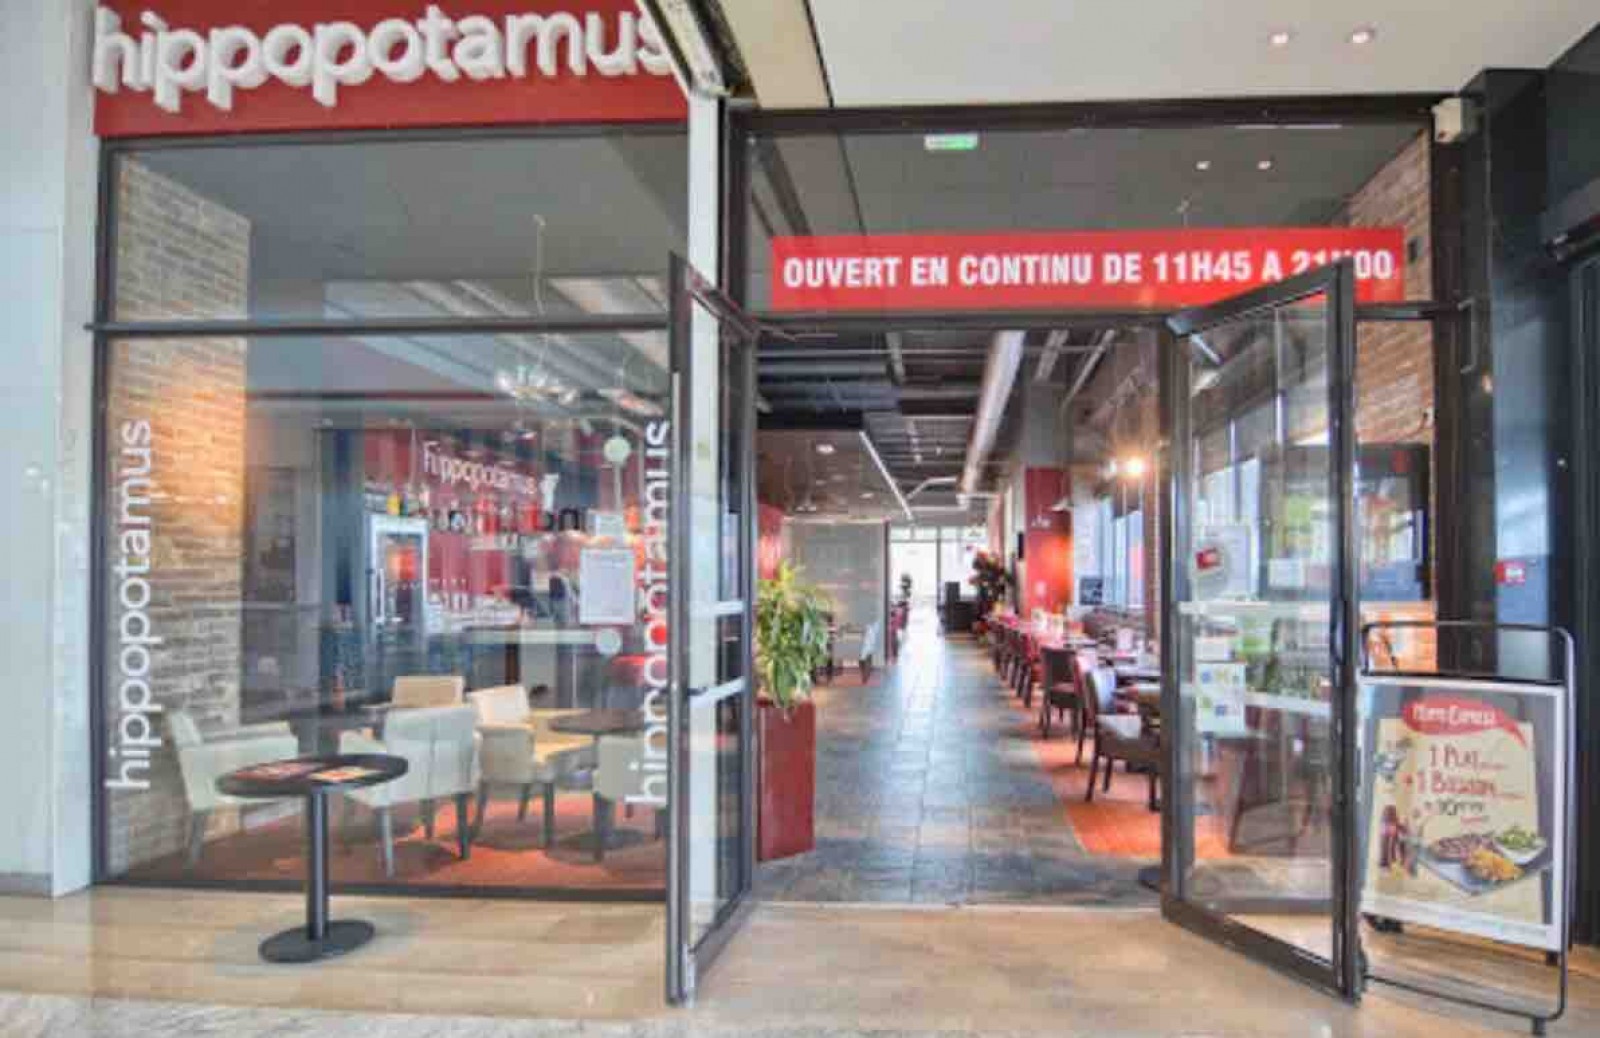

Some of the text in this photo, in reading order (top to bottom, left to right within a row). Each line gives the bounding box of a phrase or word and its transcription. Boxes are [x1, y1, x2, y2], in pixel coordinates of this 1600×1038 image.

[93, 4, 676, 113] hippopotamus
[783, 249, 1394, 287] OUVERT EN CONTINU DE 11H45 A 2100
[105, 419, 161, 790] hippopotamus
[625, 420, 669, 807] hippopotamus
